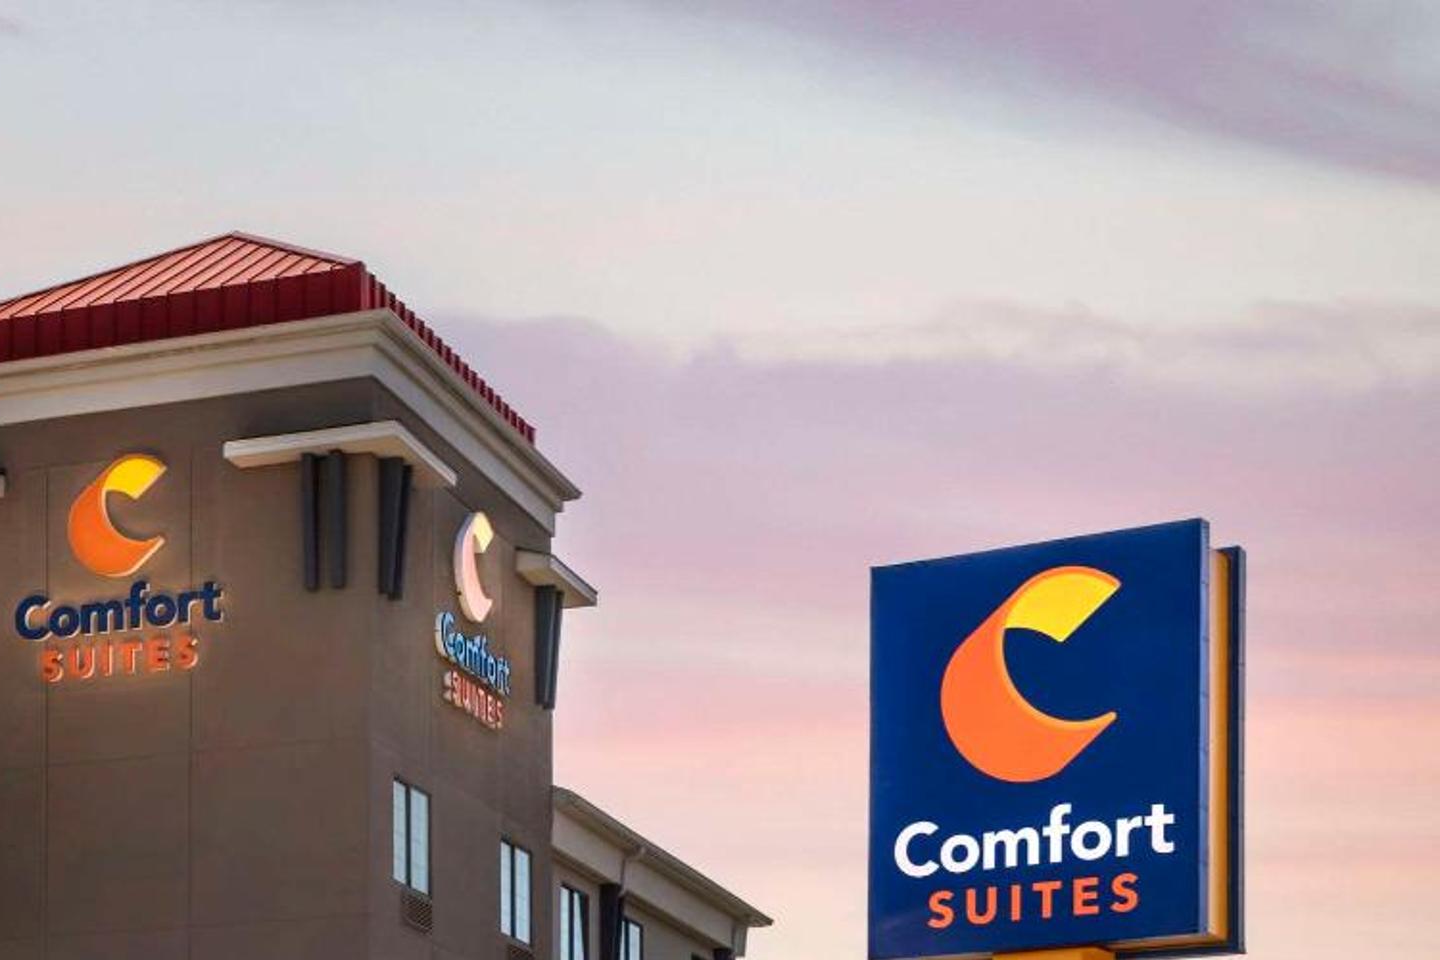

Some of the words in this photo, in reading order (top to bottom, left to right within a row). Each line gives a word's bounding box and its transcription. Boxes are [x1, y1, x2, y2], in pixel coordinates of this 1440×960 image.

[15, 580, 224, 641] Comfort
[40, 633, 201, 682] SUITES
[435, 611, 511, 697] Comfort
[444, 670, 503, 729] SUITES
[894, 803, 1175, 878] Comfort
[927, 872, 1140, 929] SUITES
